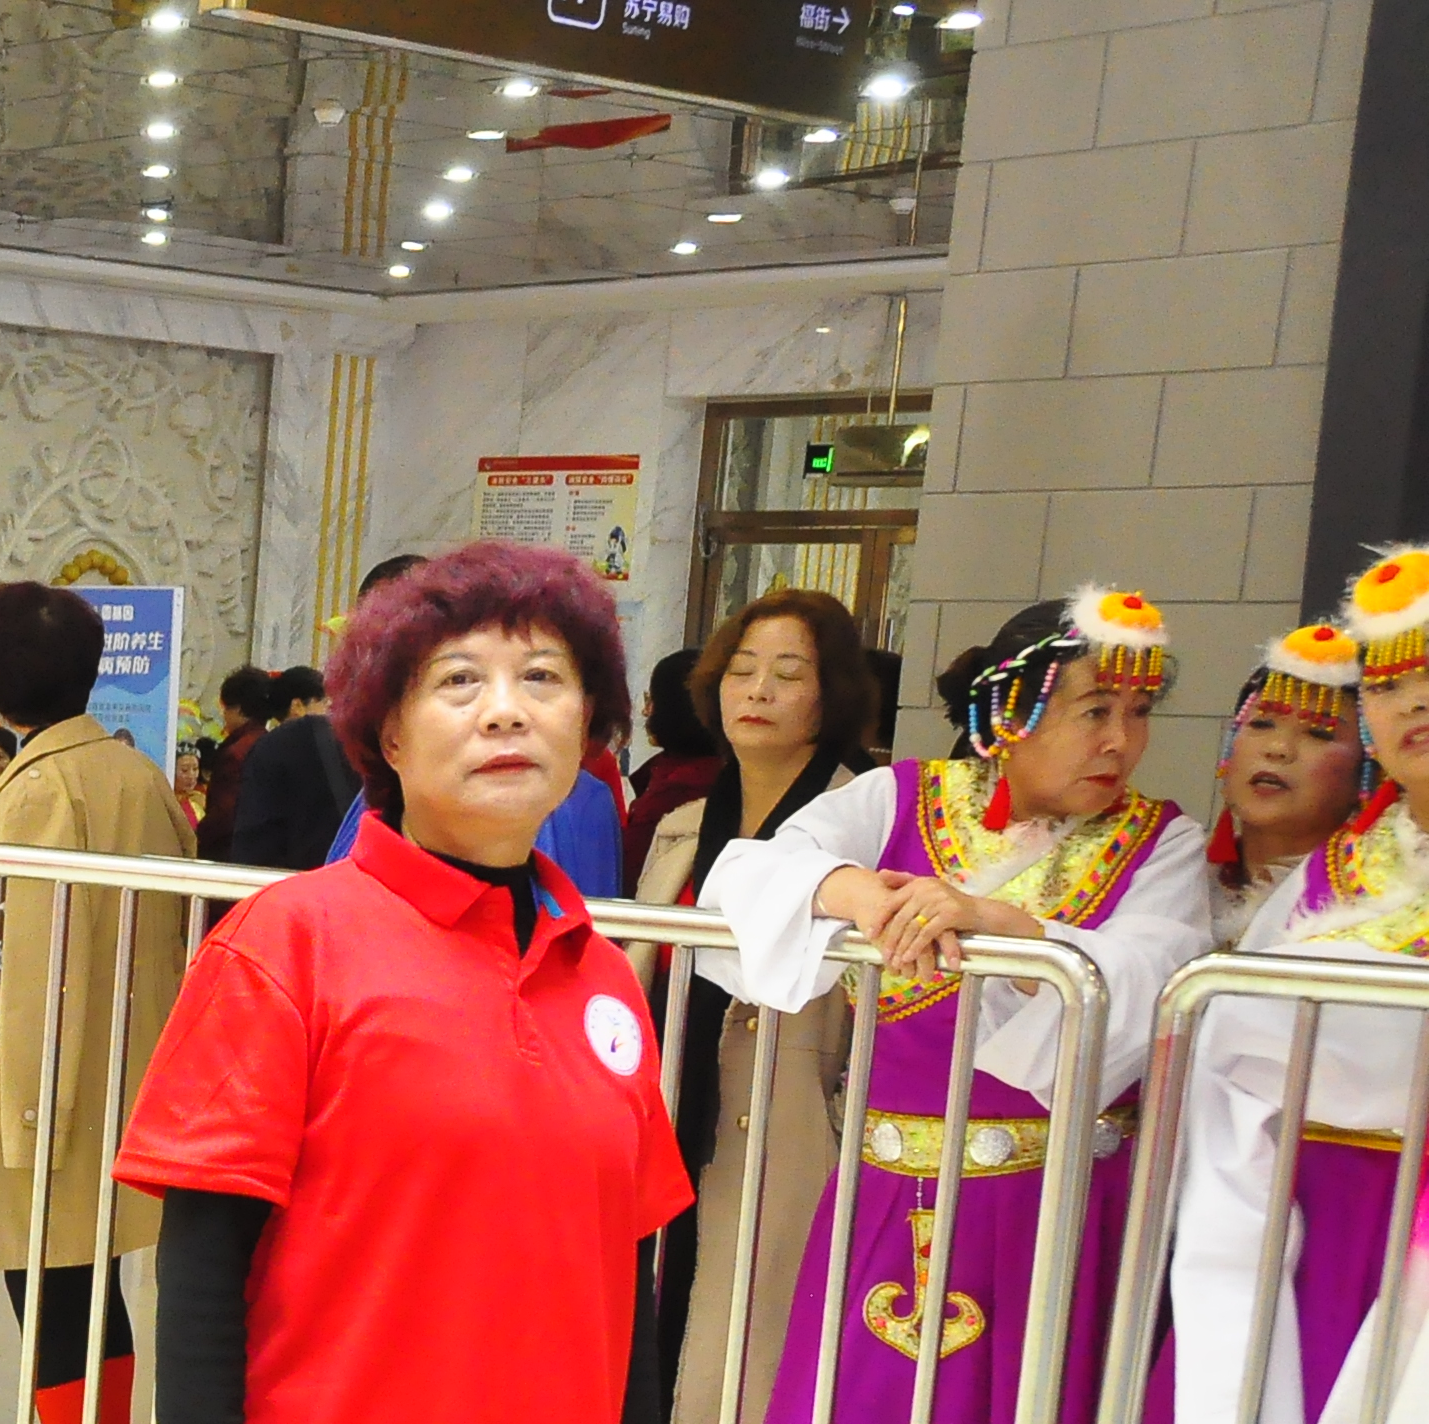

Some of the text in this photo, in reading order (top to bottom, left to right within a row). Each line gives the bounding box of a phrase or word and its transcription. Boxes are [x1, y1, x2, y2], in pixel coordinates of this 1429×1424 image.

[624, 0, 690, 29] 苏宁易购
[799, 3, 832, 32] 福街
[622, 22, 651, 39] Suning
